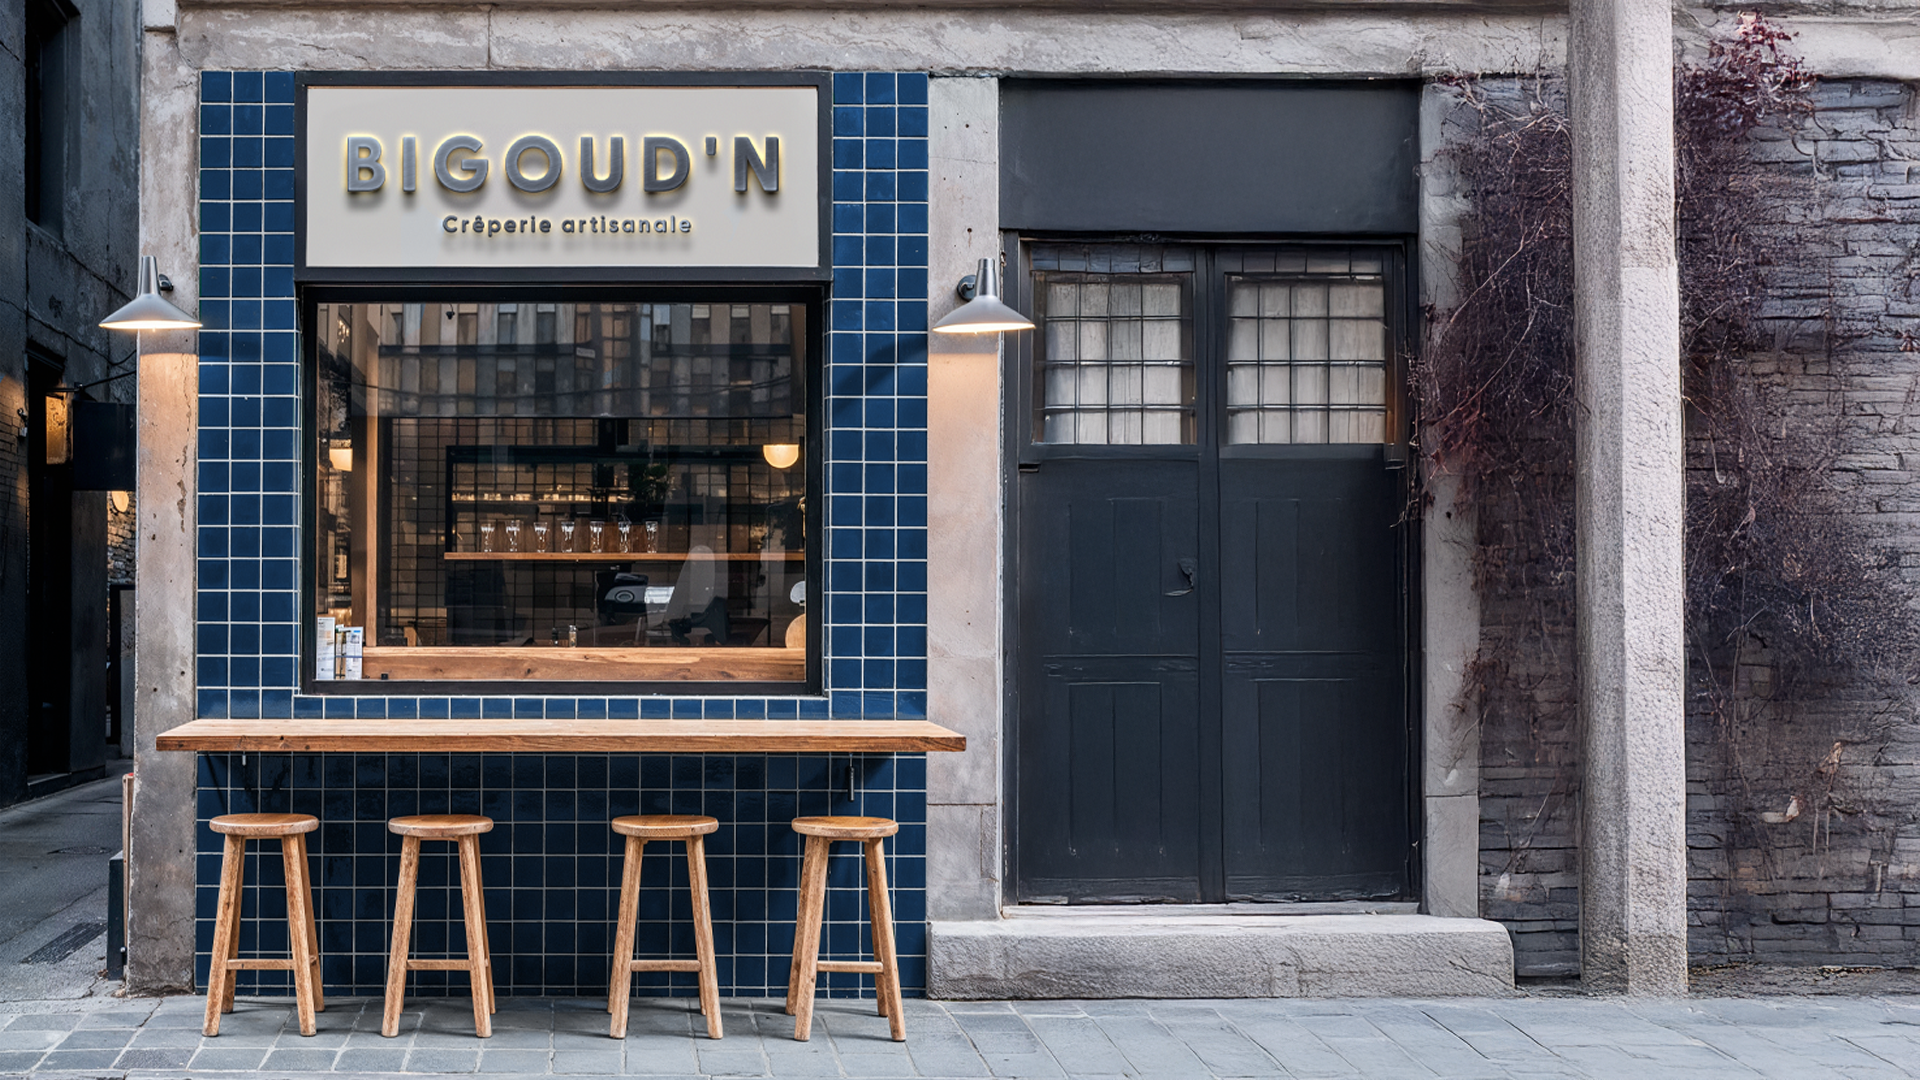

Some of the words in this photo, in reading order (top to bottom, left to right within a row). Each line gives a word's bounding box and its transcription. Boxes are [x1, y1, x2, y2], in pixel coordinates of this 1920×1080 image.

[346, 135, 780, 193] BIGOUD'N
[443, 215, 552, 237] Crêperie
[561, 215, 692, 234] artisanale
